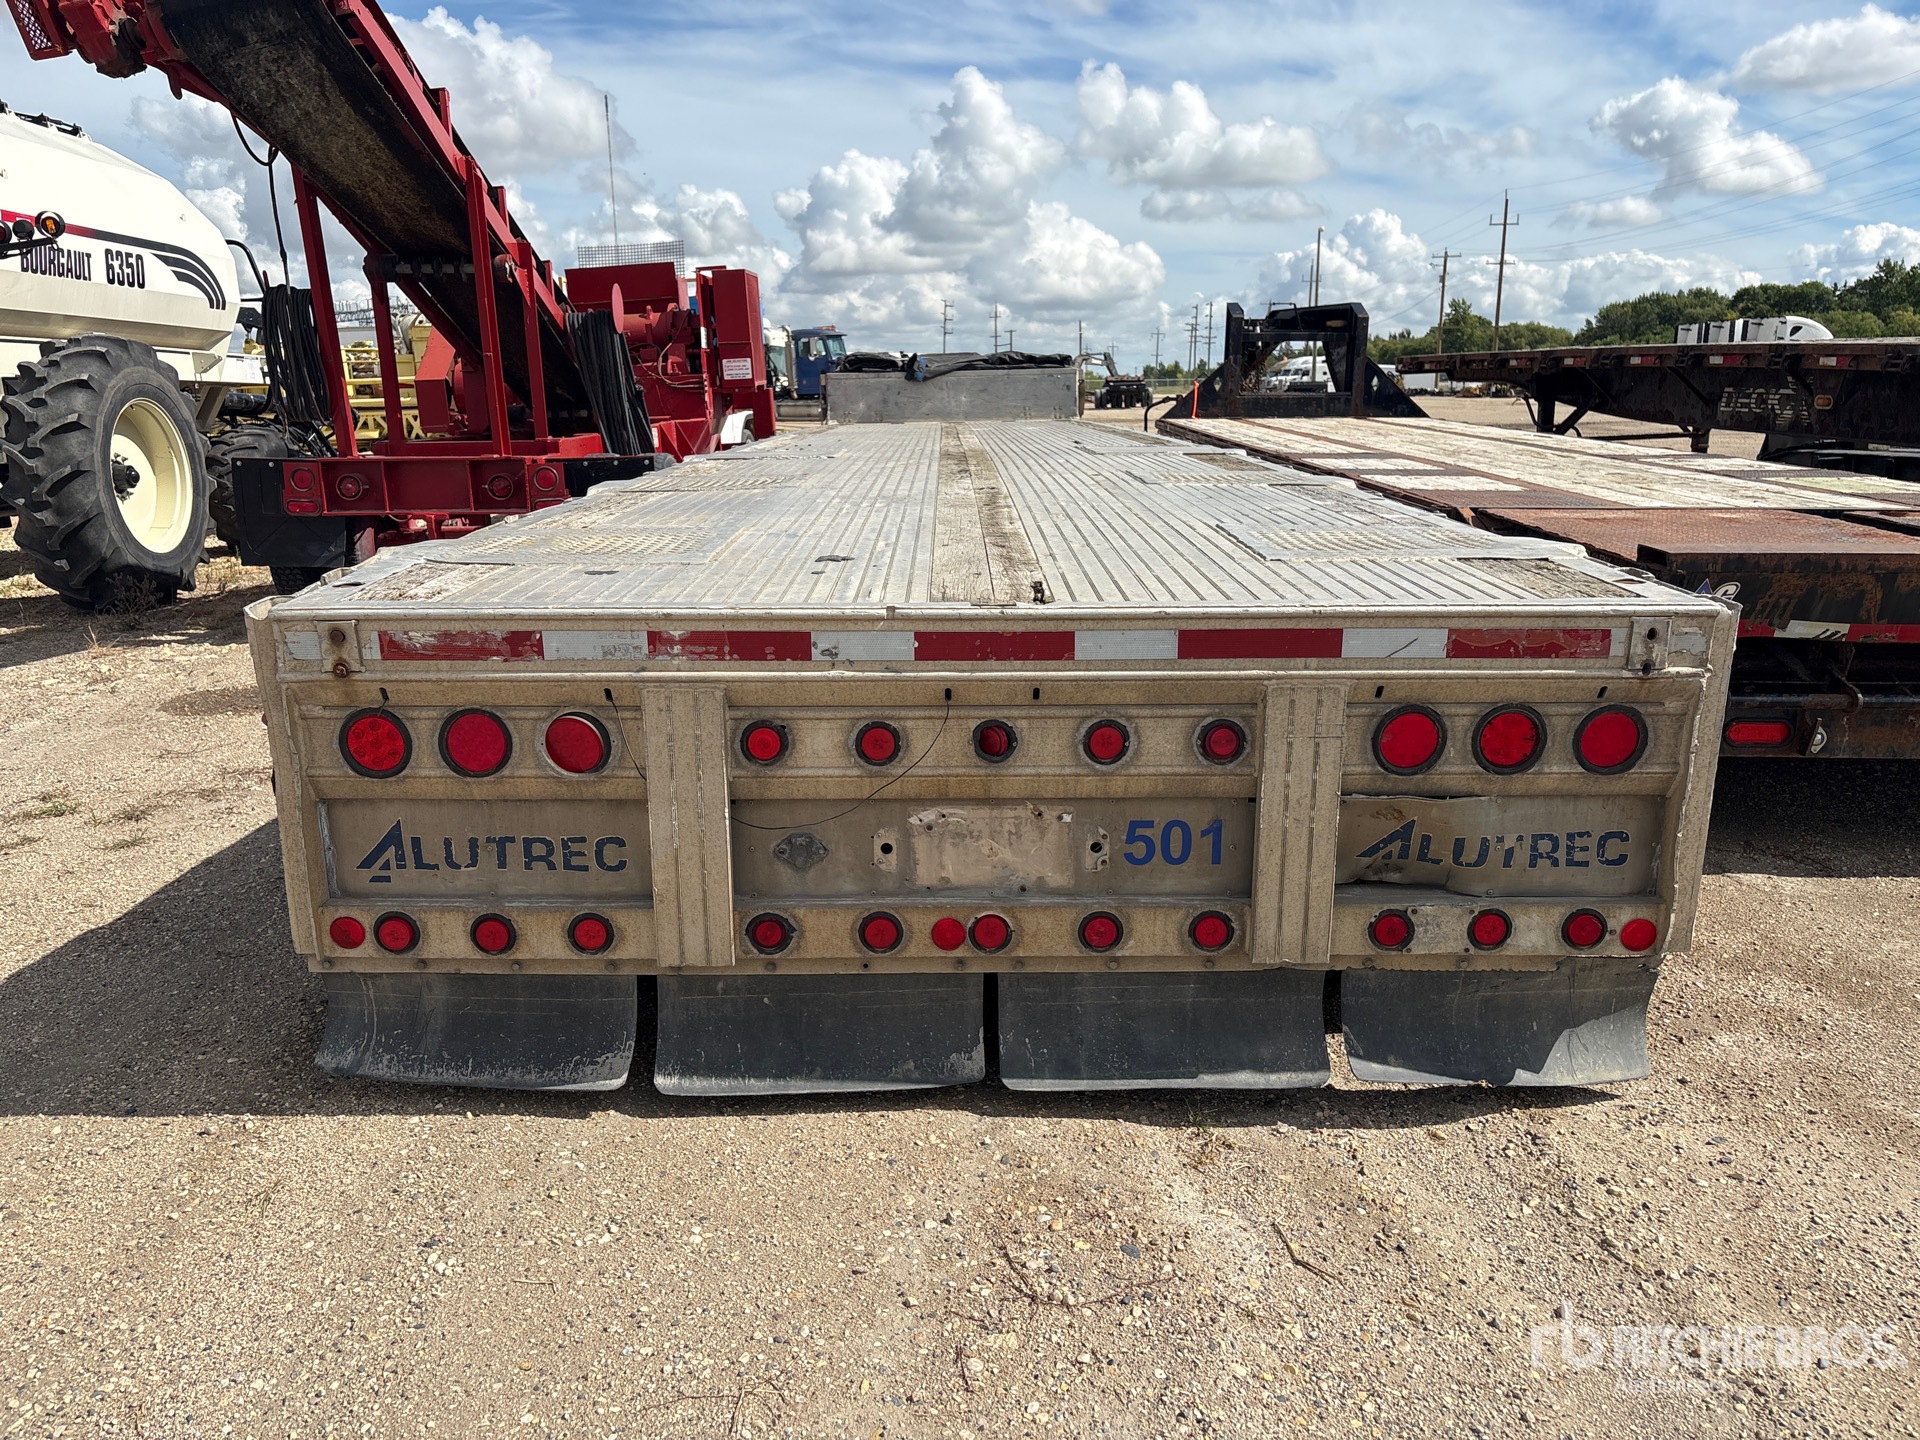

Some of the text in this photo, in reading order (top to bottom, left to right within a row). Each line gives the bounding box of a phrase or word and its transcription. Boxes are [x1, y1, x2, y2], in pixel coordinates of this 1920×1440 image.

[20, 244, 145, 289] BOURGAULT 6350
[355, 818, 628, 883] ALUTREC
[1123, 819, 1223, 866] 501
[1355, 816, 1631, 869] ALUTREC
